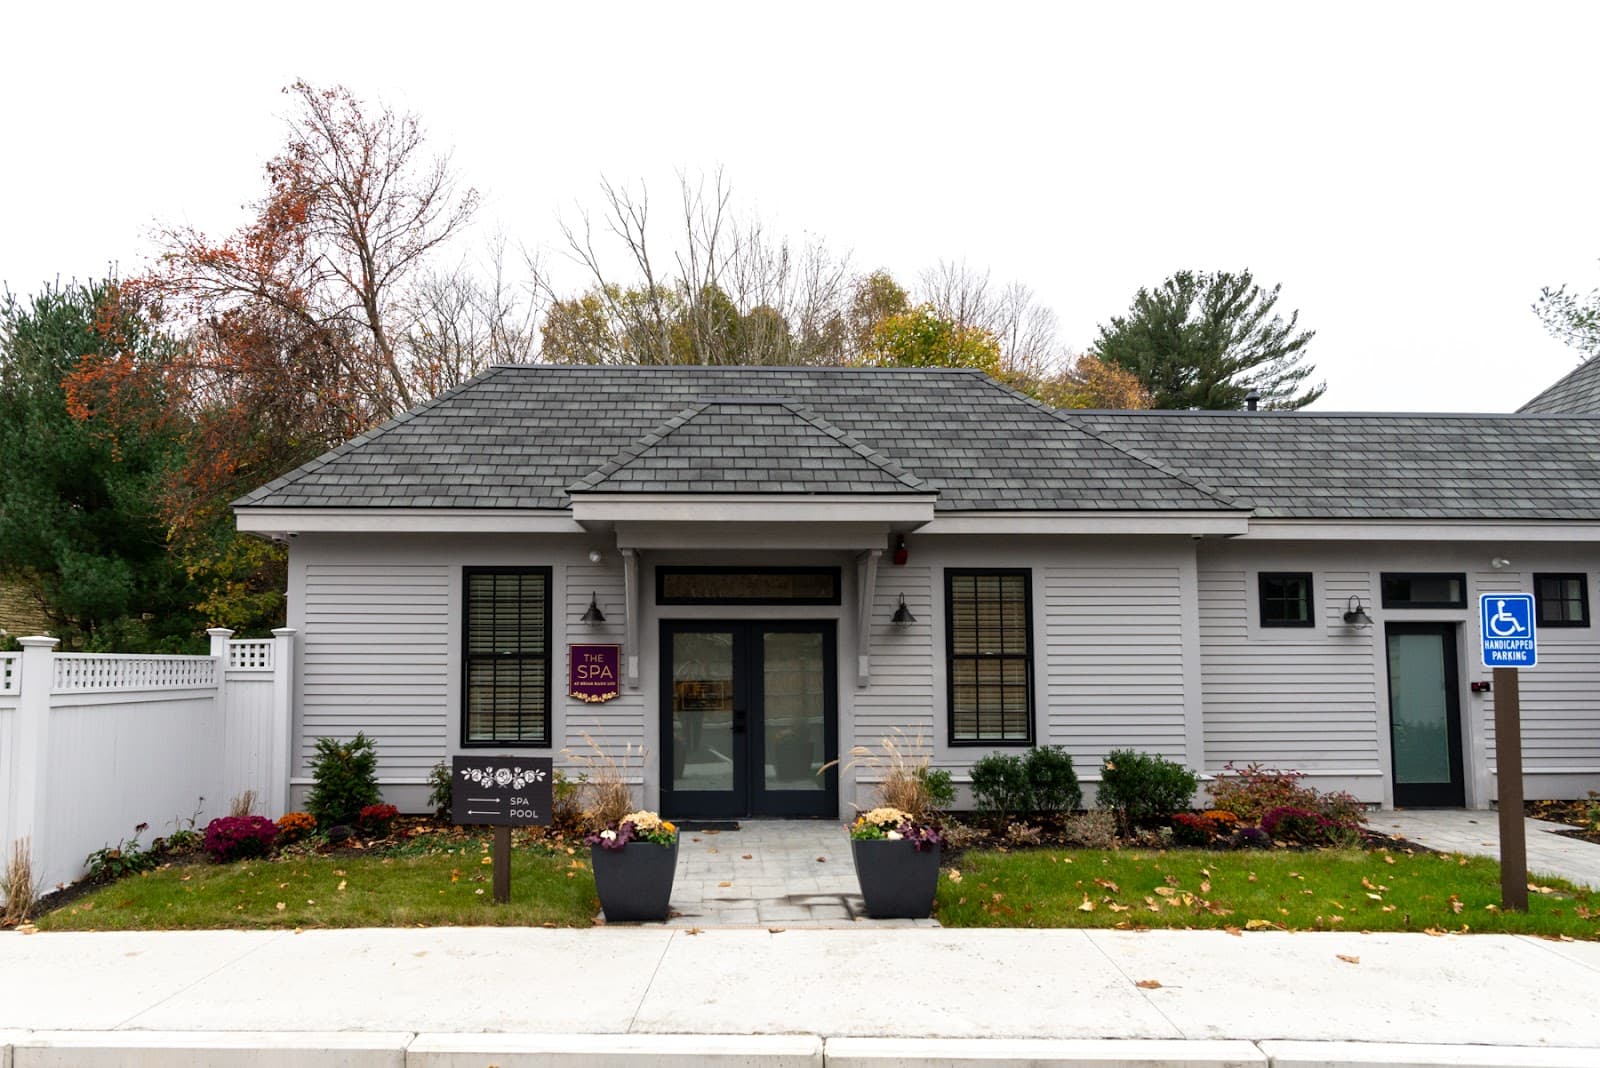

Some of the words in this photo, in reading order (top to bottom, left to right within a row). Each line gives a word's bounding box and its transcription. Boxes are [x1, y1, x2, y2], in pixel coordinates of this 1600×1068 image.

[1484, 639, 1534, 650] HANDICAPPED
[583, 653, 605, 663] THE
[1492, 650, 1527, 661] PARKING
[577, 664, 613, 679] SPA
[510, 797, 529, 806] SPA
[510, 809, 539, 818] POOL
